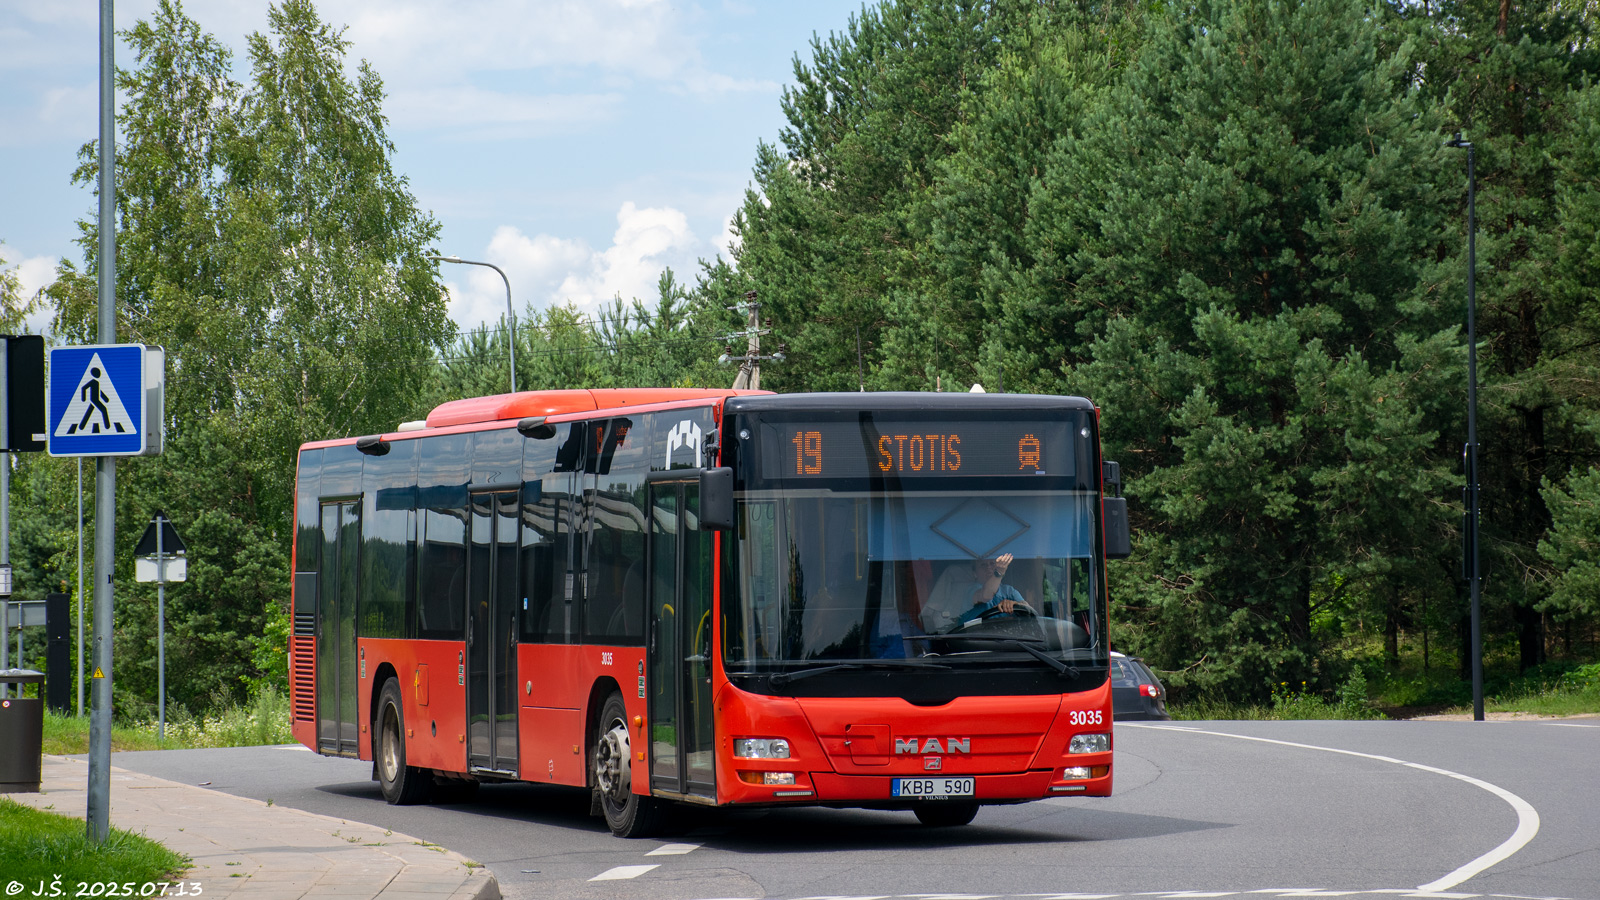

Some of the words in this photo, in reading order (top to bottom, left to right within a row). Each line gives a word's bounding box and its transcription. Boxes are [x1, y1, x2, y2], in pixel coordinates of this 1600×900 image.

[792, 431, 822, 474] 19
[878, 434, 961, 471] STOTIS
[601, 652, 613, 666] 3035
[1069, 710, 1103, 725] 3035
[894, 737, 971, 754] MAN
[902, 780, 934, 795] KBB
[944, 779, 971, 794] 590
